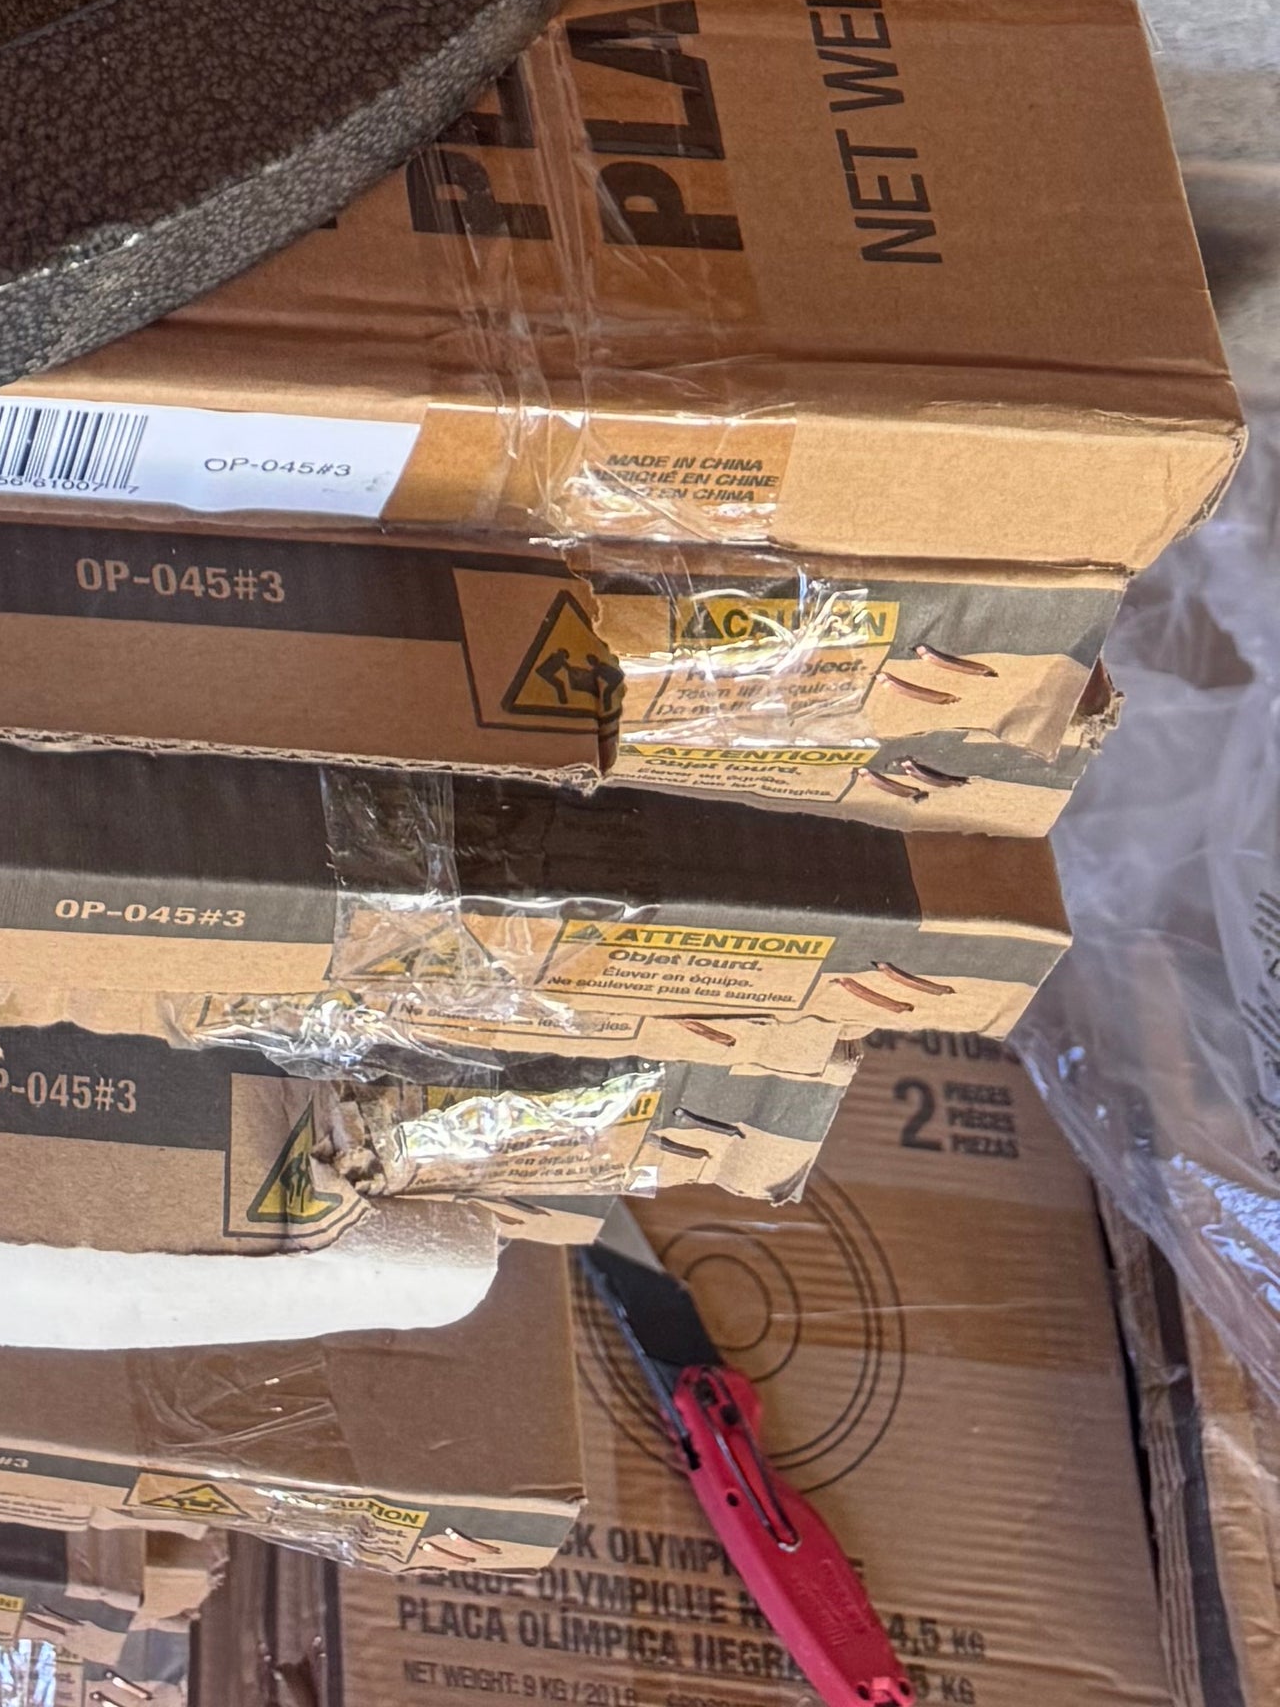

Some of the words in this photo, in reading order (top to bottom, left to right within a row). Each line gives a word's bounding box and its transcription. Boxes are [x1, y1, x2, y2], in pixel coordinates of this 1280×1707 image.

[836, 131, 943, 264] NET
[203, 456, 352, 478] OP-045#3
[606, 454, 671, 469] MADE
[672, 455, 697, 470] IN
[699, 456, 764, 473] CHINA
[33, 477, 105, 493] 61007
[128, 485, 141, 495] 7
[680, 472, 711, 486] EN
[714, 473, 780, 488] CHINE
[692, 487, 756, 502] CHINA
[75, 556, 287, 605] OP-045#3
[653, 745, 867, 764] ATTENTION!
[723, 761, 804, 777] lourd.
[55, 898, 247, 928] OP-045#3
[613, 928, 825, 956] ATTENTION!
[608, 949, 683, 968] Objet
[688, 954, 764, 973] lourd.
[547, 975, 574, 988] Ne
[576, 977, 654, 995] soulevez
[656, 984, 691, 996] pas
[694, 987, 722, 998] les
[723, 990, 798, 1005] sangles.
[661, 973, 685, 983] en
[689, 973, 755, 989] équipe.
[893, 1076, 945, 1152] 2
[397, 1593, 509, 1643] PLACA
[940, 1674, 976, 1705] KG
[952, 1627, 987, 1657] KG
[403, 1659, 439, 1685] NET
[444, 1664, 520, 1697] WEIGHT:
[522, 1673, 538, 1697] 9
